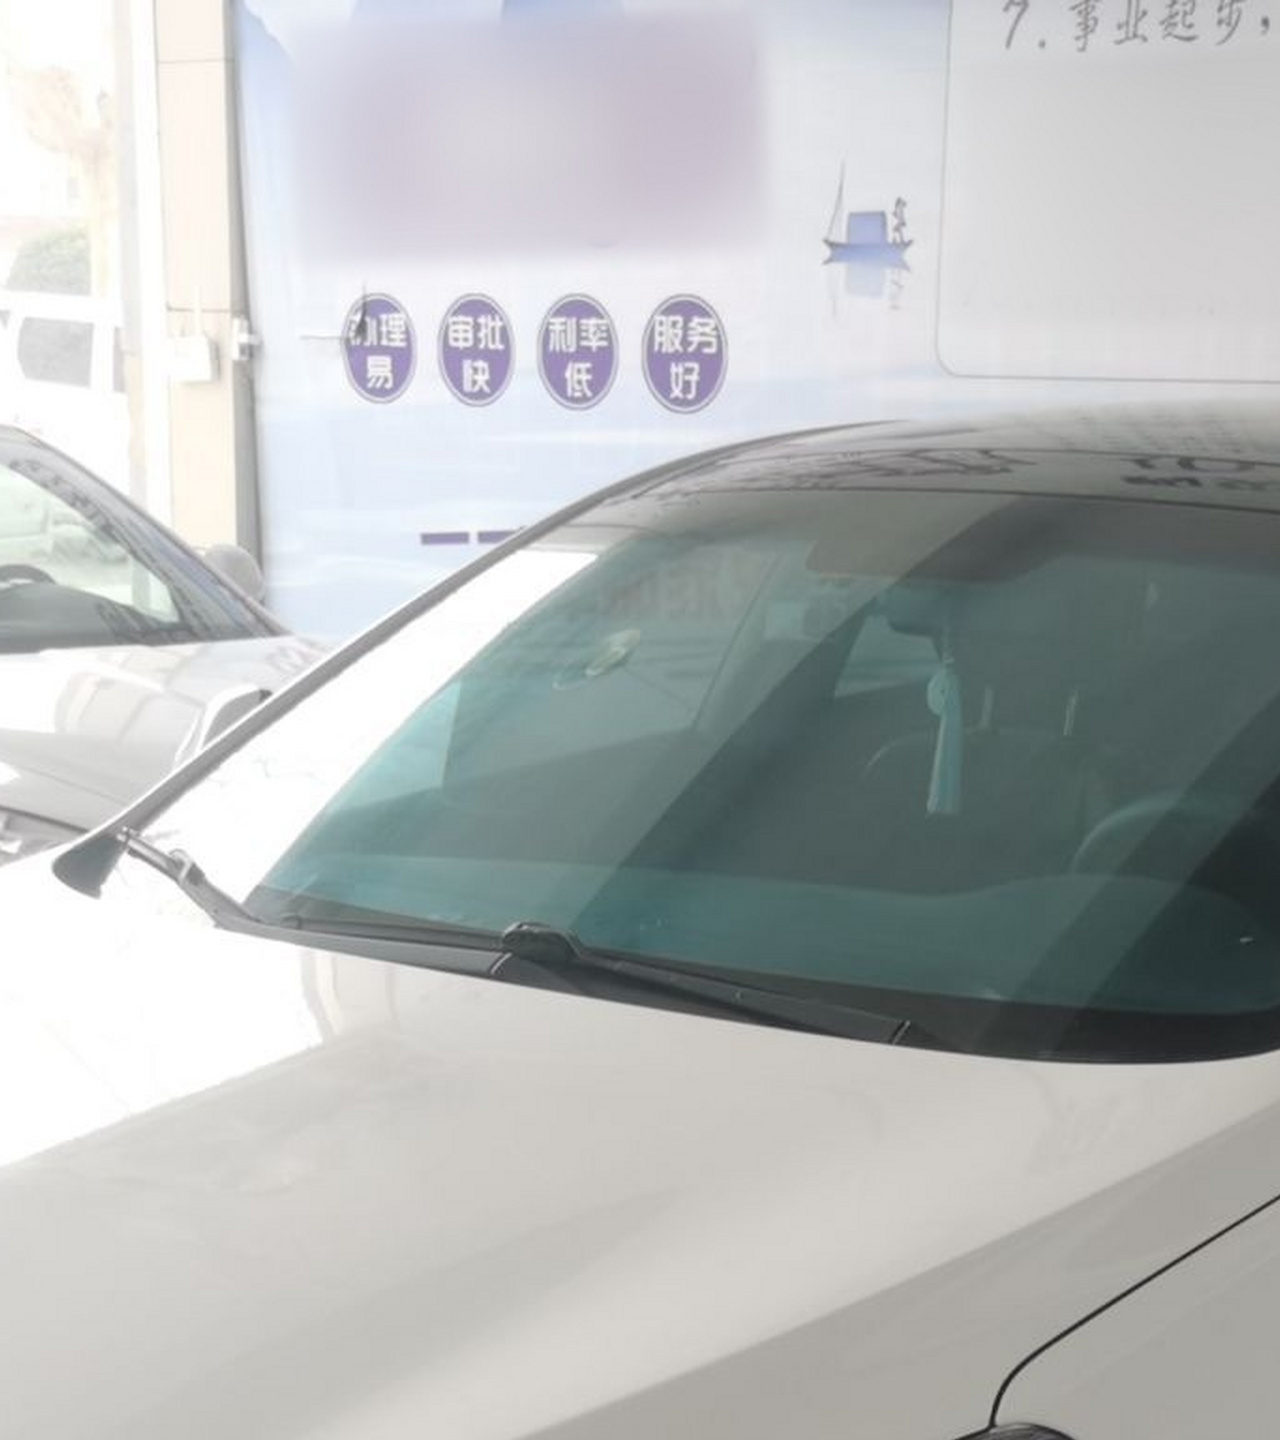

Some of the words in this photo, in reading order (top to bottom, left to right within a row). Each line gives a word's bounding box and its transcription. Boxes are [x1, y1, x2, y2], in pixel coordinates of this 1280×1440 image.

[448, 314, 504, 349] 审批
[548, 317, 609, 352] 利率
[654, 315, 717, 353] 服务
[367, 355, 393, 389] 易
[463, 360, 491, 393] 快
[565, 362, 592, 397] 低
[670, 362, 699, 399] 好
